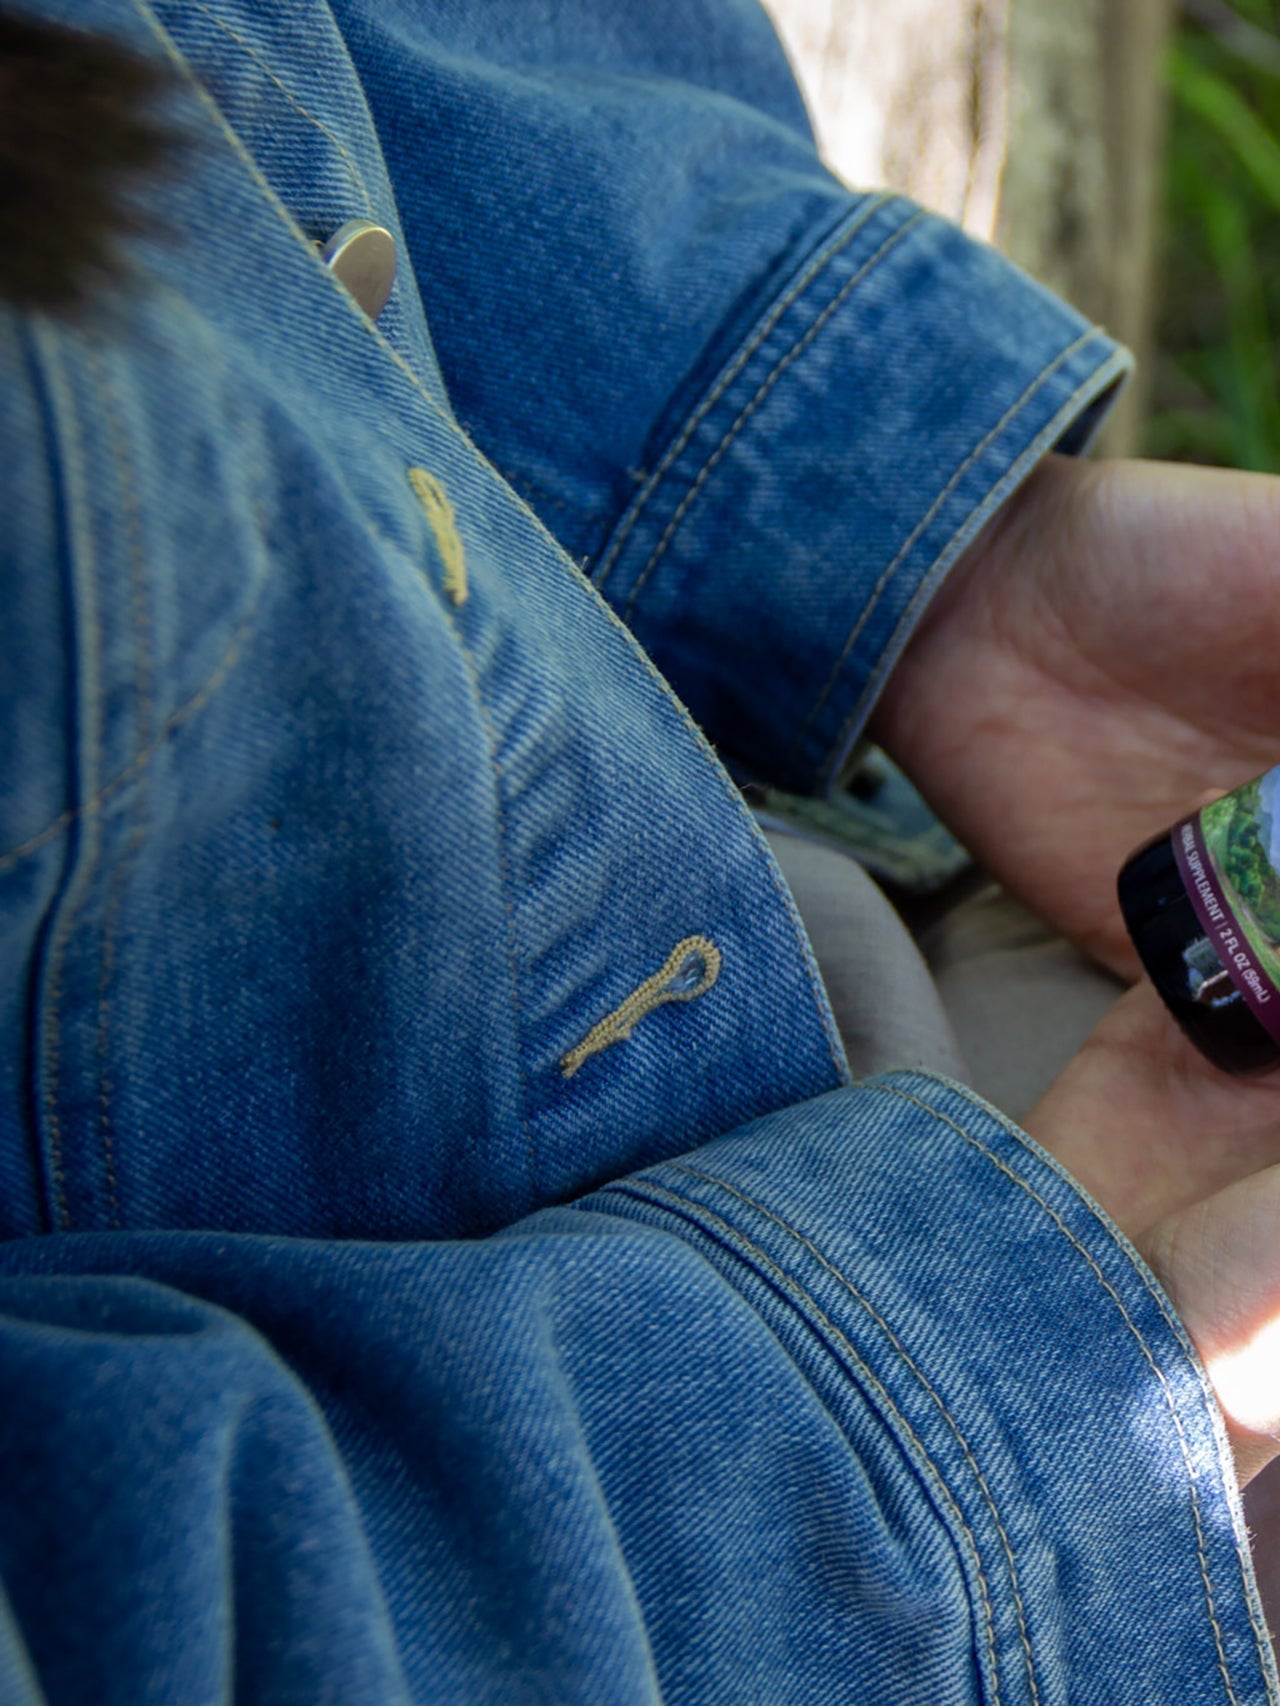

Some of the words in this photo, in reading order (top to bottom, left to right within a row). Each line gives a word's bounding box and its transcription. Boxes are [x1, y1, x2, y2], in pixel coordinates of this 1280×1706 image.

[1186, 850, 1225, 924] SUPPLEMENT
[1219, 927, 1233, 939] 2
[1224, 936, 1240, 955] FL
[1233, 952, 1251, 970] OZ
